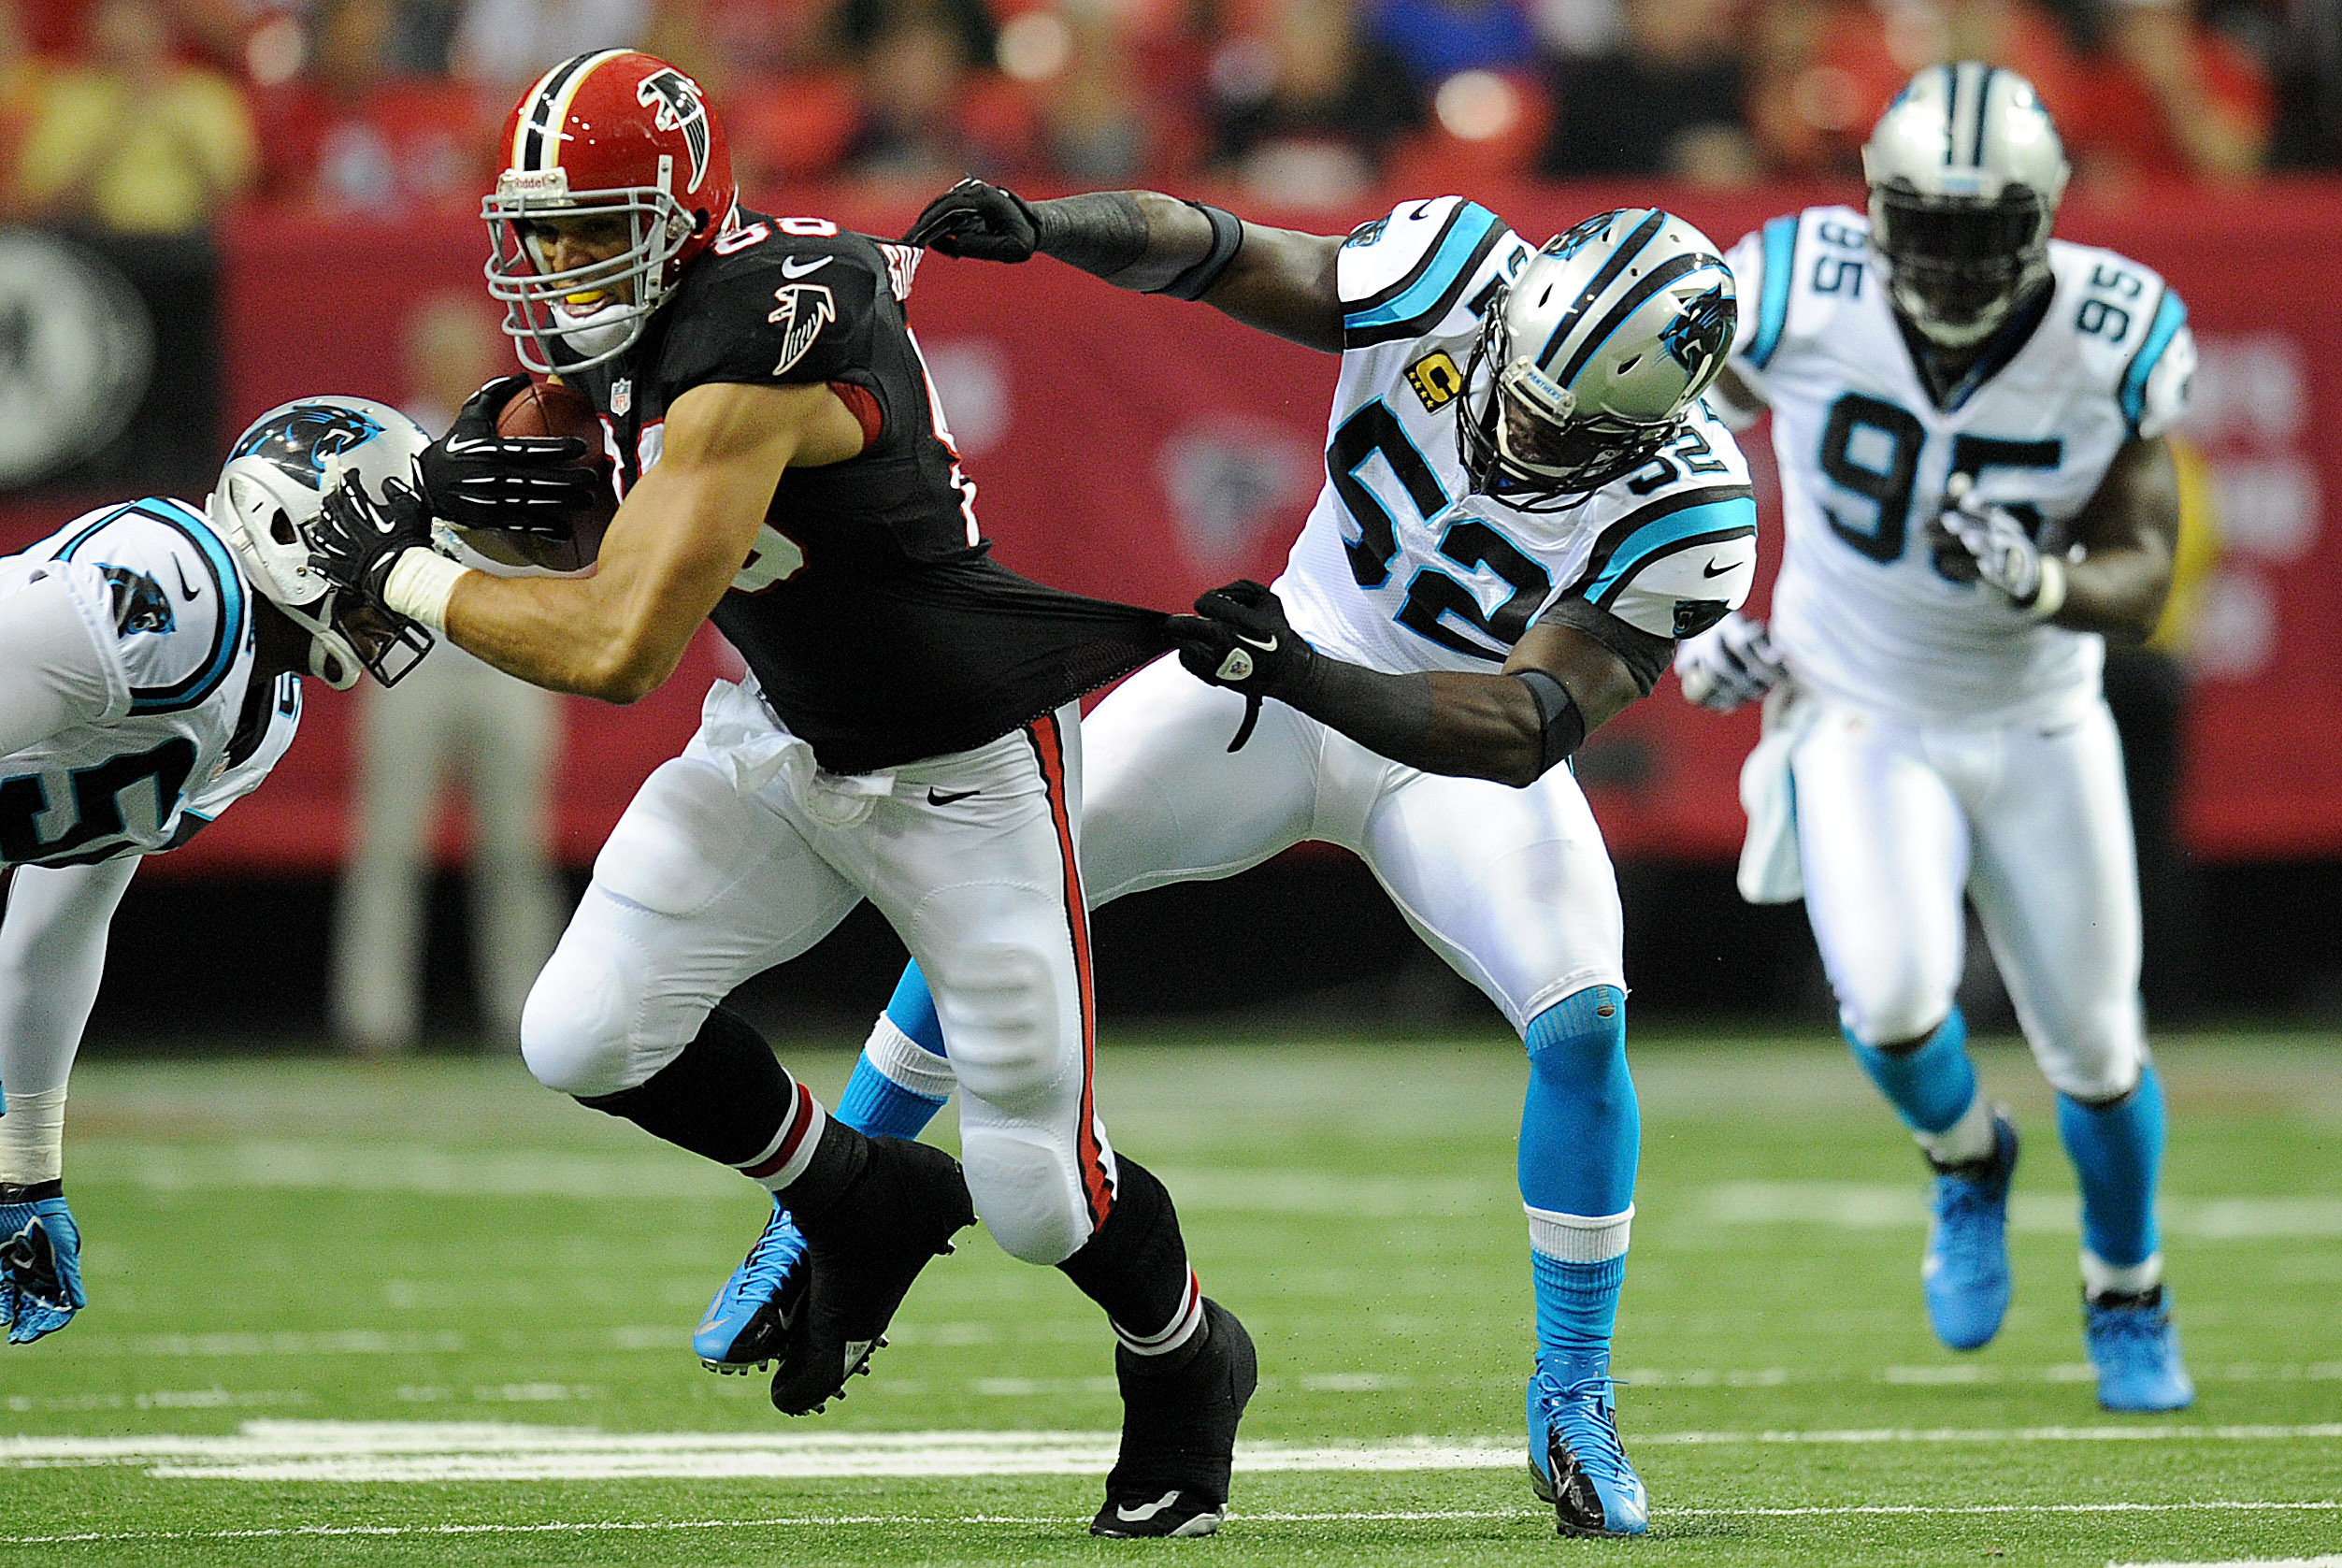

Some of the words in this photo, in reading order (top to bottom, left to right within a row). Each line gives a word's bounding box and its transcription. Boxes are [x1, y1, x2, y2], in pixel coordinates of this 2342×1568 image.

[1813, 221, 1867, 298] 95
[2076, 263, 2143, 343] 95
[1415, 353, 1461, 403] C
[1527, 370, 1562, 400] PANTHERS
[1818, 389, 2064, 586] 95
[1326, 393, 1556, 664] 52
[0, 735, 215, 862] 5
